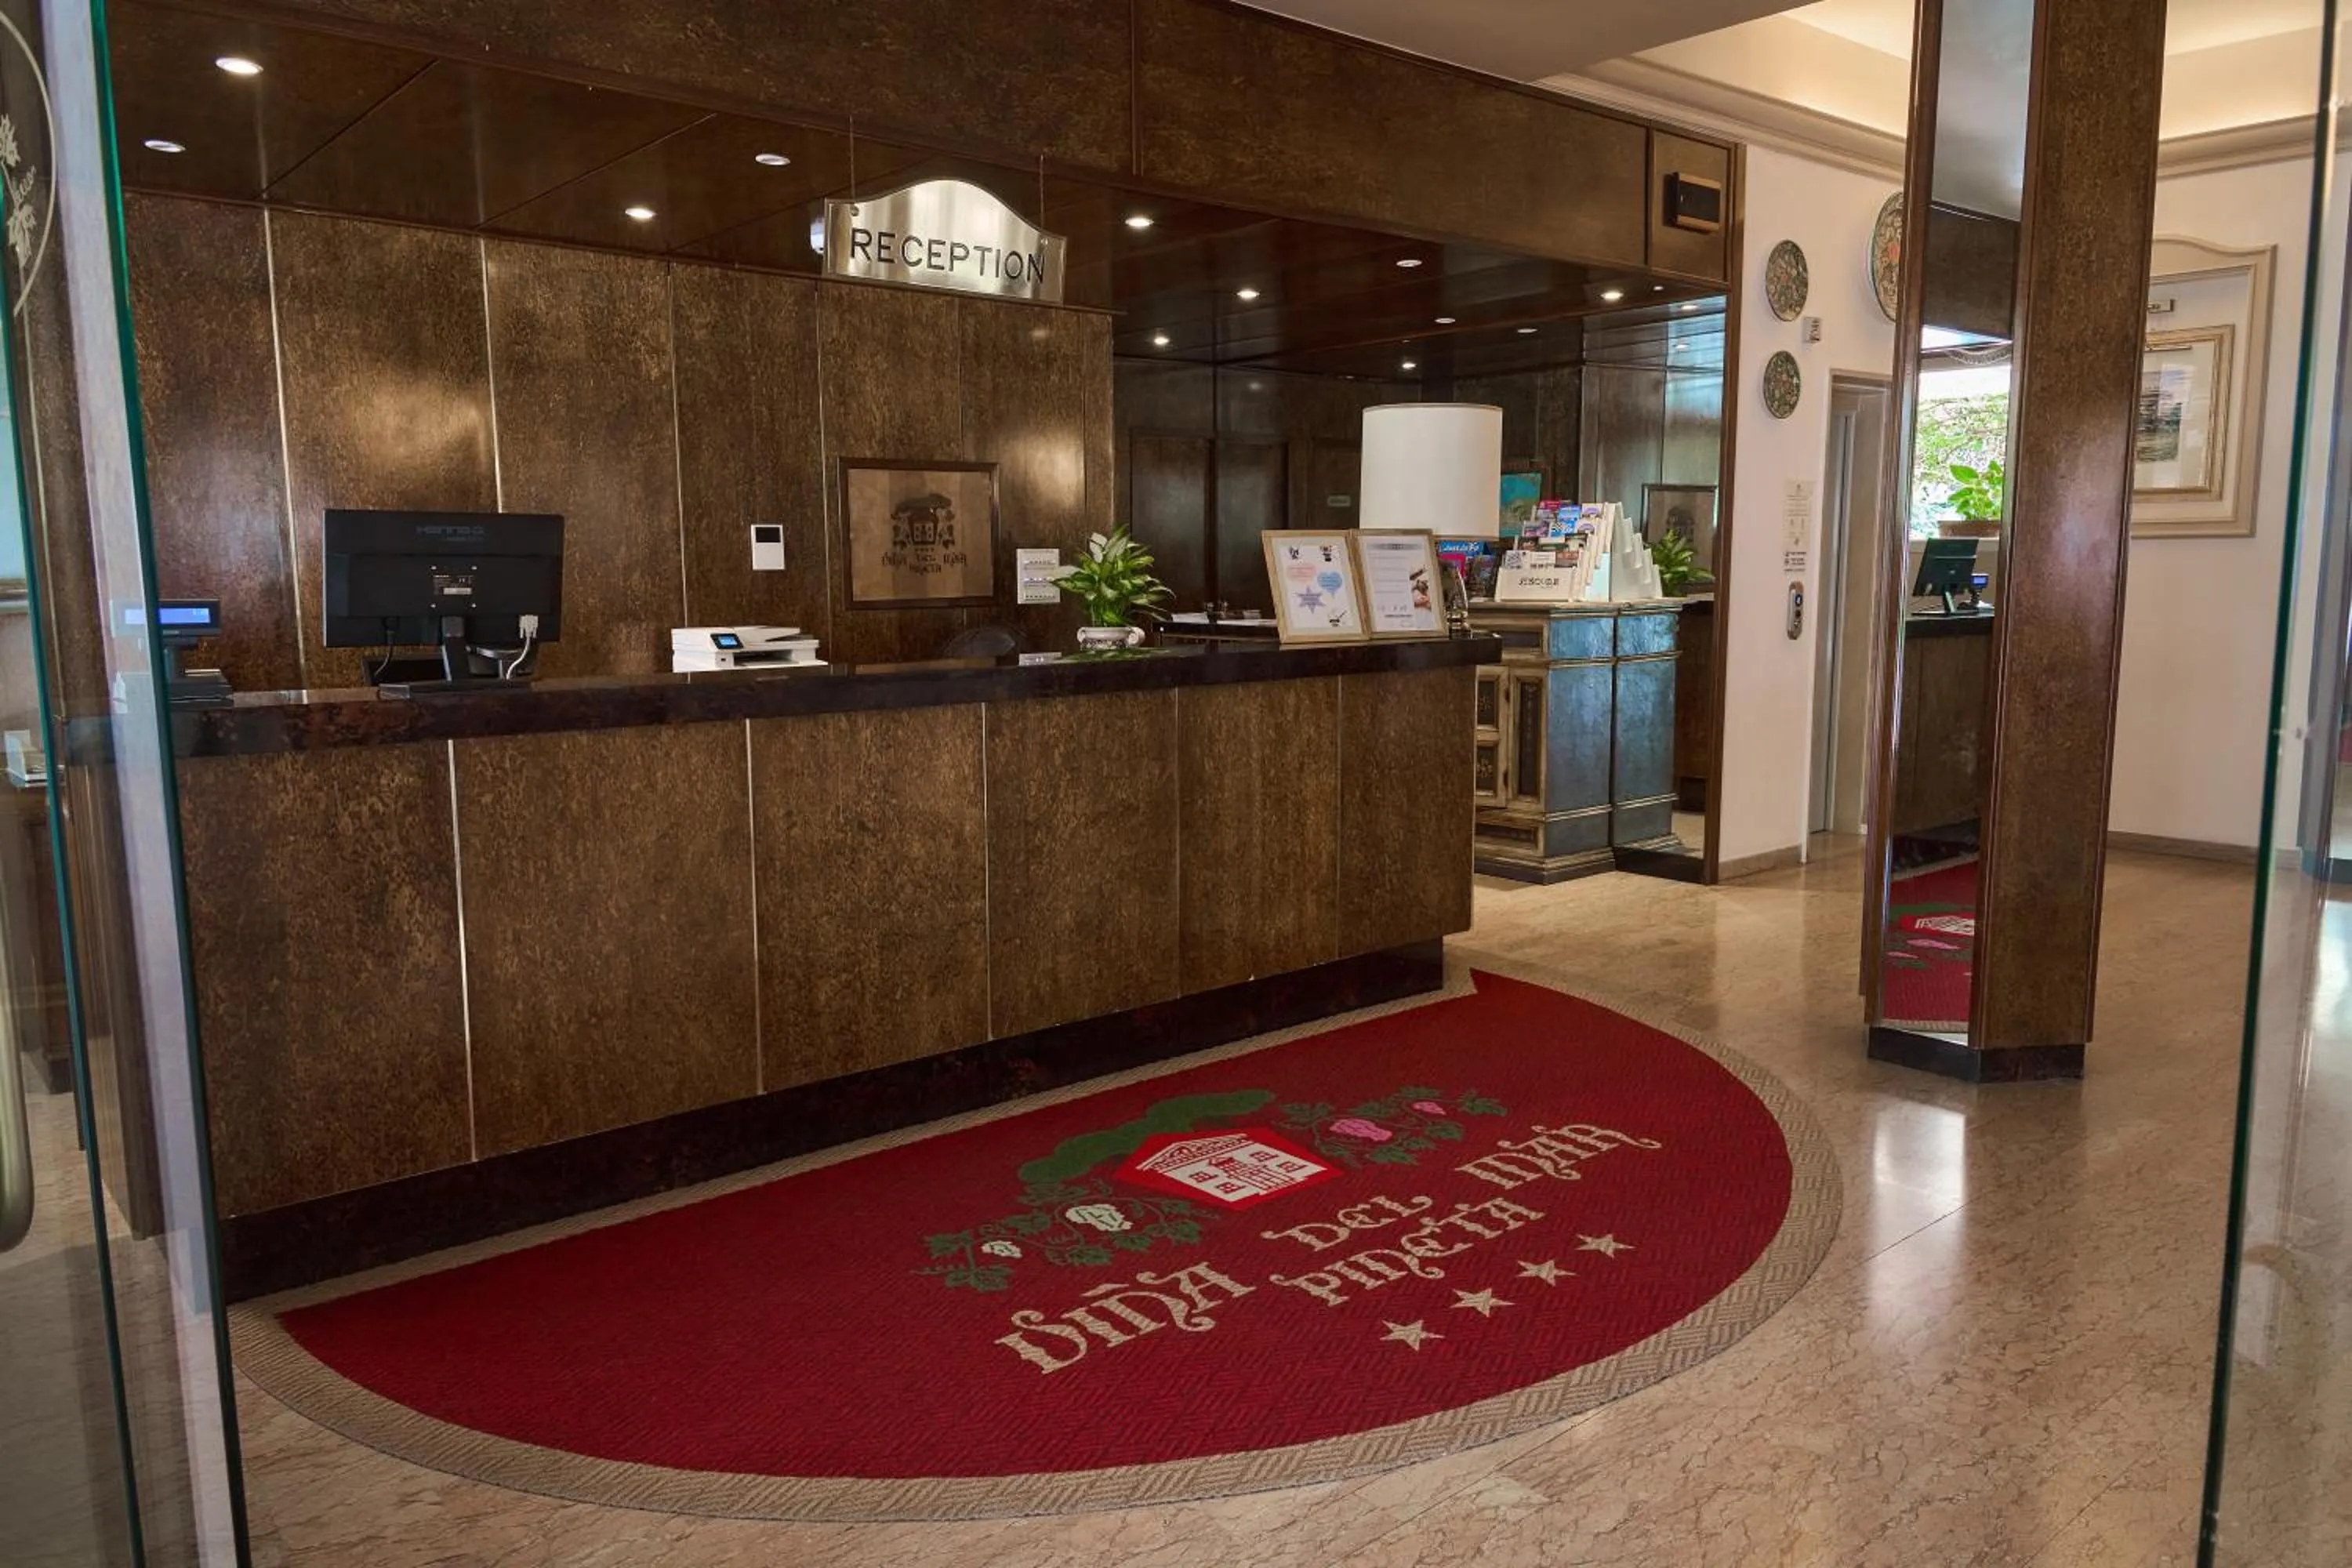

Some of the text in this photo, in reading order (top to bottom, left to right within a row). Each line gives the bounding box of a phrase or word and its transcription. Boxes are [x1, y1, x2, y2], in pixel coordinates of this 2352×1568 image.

[850, 227, 1046, 284] RECEPTION
[1260, 1195, 1433, 1251] DEL
[1455, 1123, 1662, 1190] MAR
[1269, 1197, 1545, 1306] PINETA
